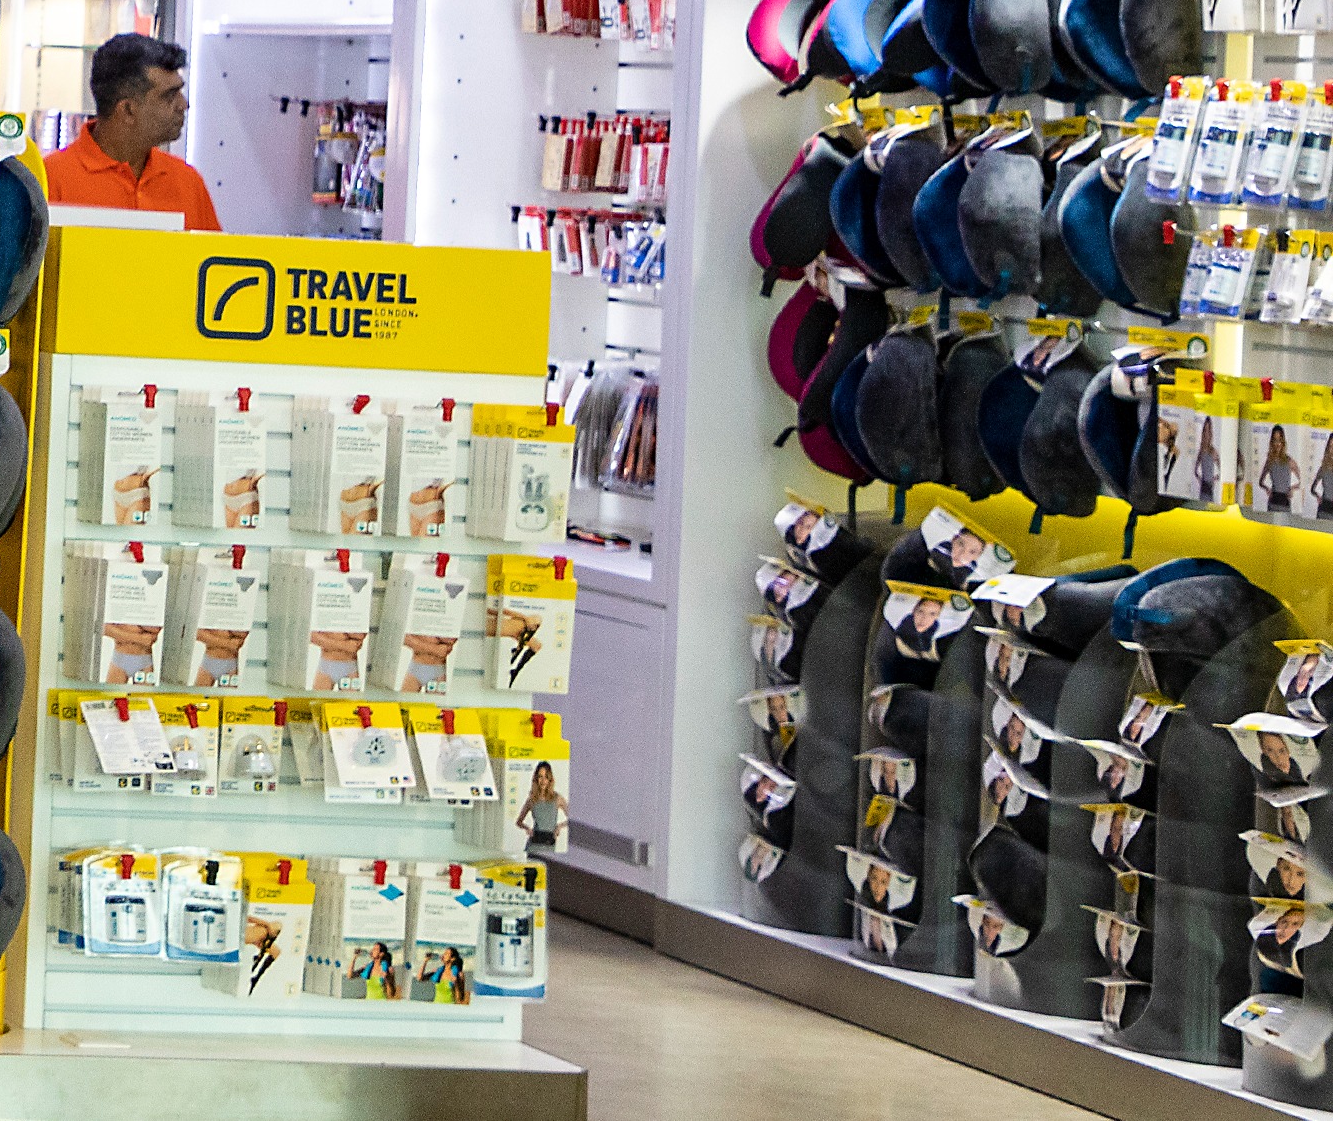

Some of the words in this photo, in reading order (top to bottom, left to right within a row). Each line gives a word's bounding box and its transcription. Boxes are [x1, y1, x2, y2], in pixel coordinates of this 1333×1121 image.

[286, 267, 417, 305] TRAVEL
[286, 305, 373, 339] BLUE
[374, 319, 402, 328] SINCE
[375, 331, 398, 340] 1987
